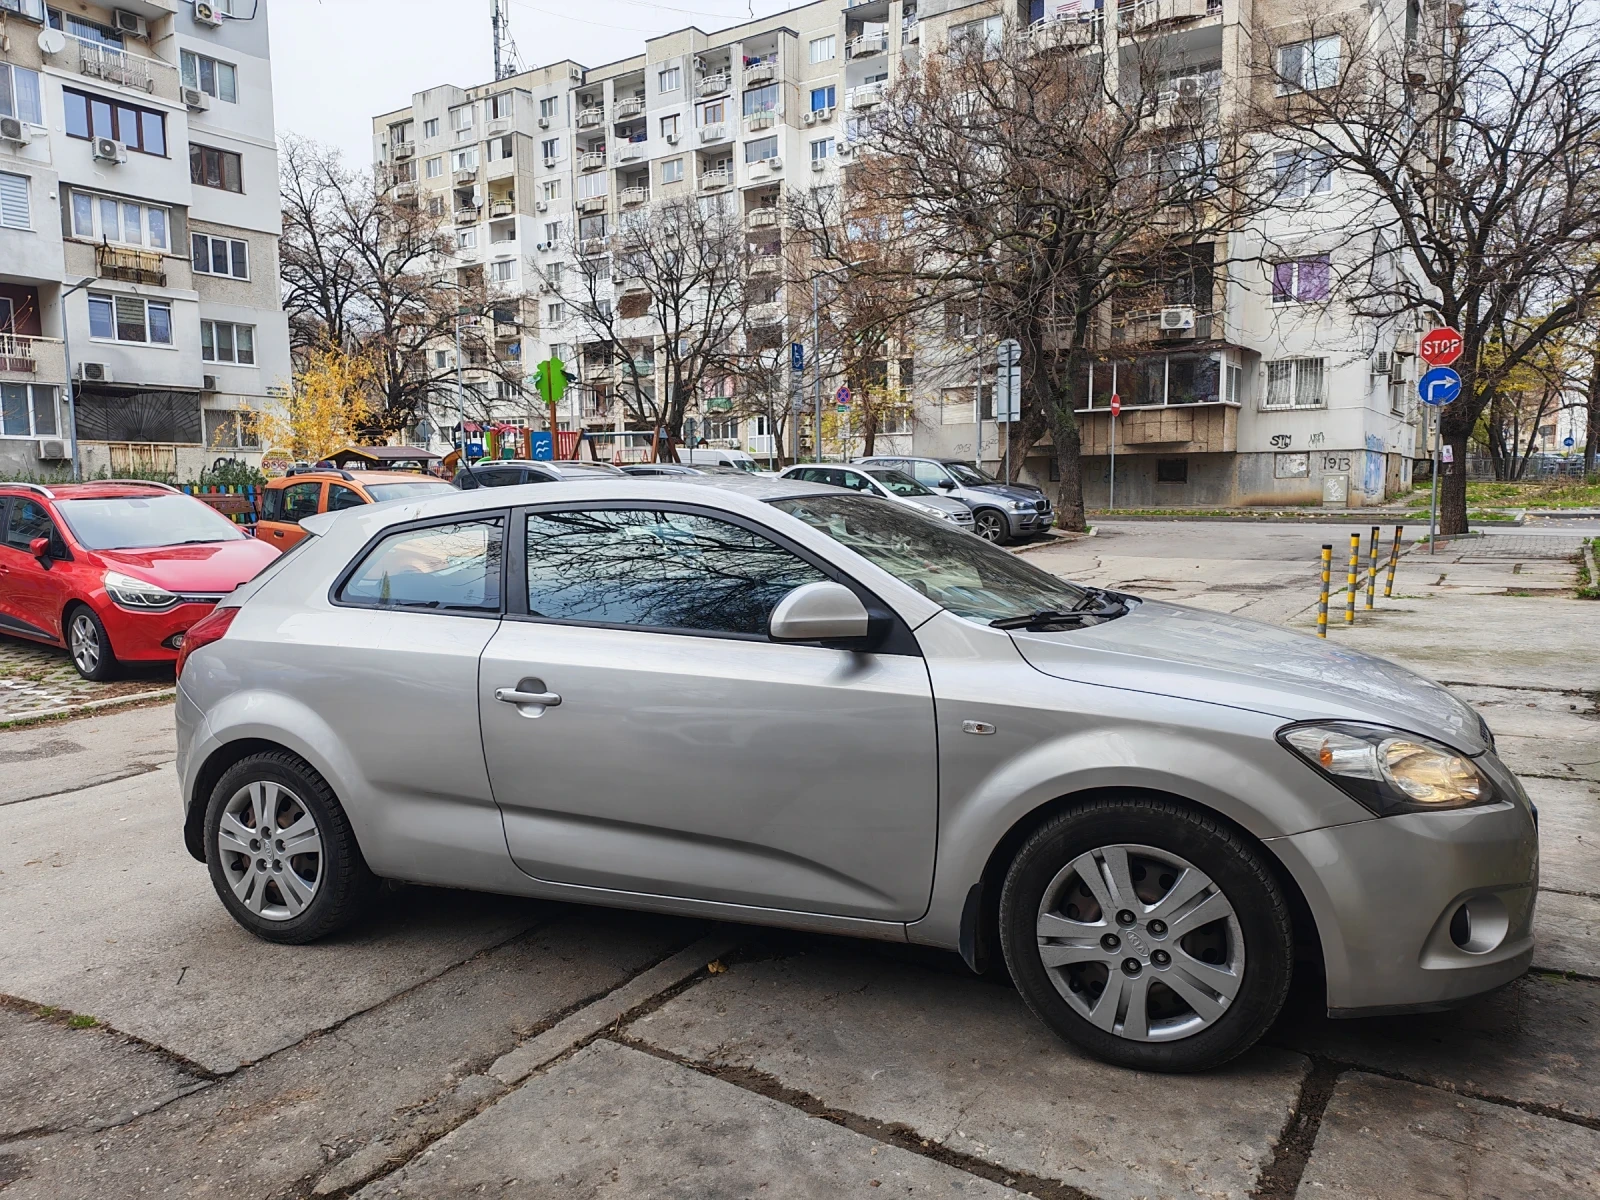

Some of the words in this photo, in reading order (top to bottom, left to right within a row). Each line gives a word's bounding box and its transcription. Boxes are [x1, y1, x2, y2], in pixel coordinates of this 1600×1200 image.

[1423, 338, 1460, 355] STOP
[1323, 456, 1351, 471] 1913
[1127, 932, 1146, 955] KIA
